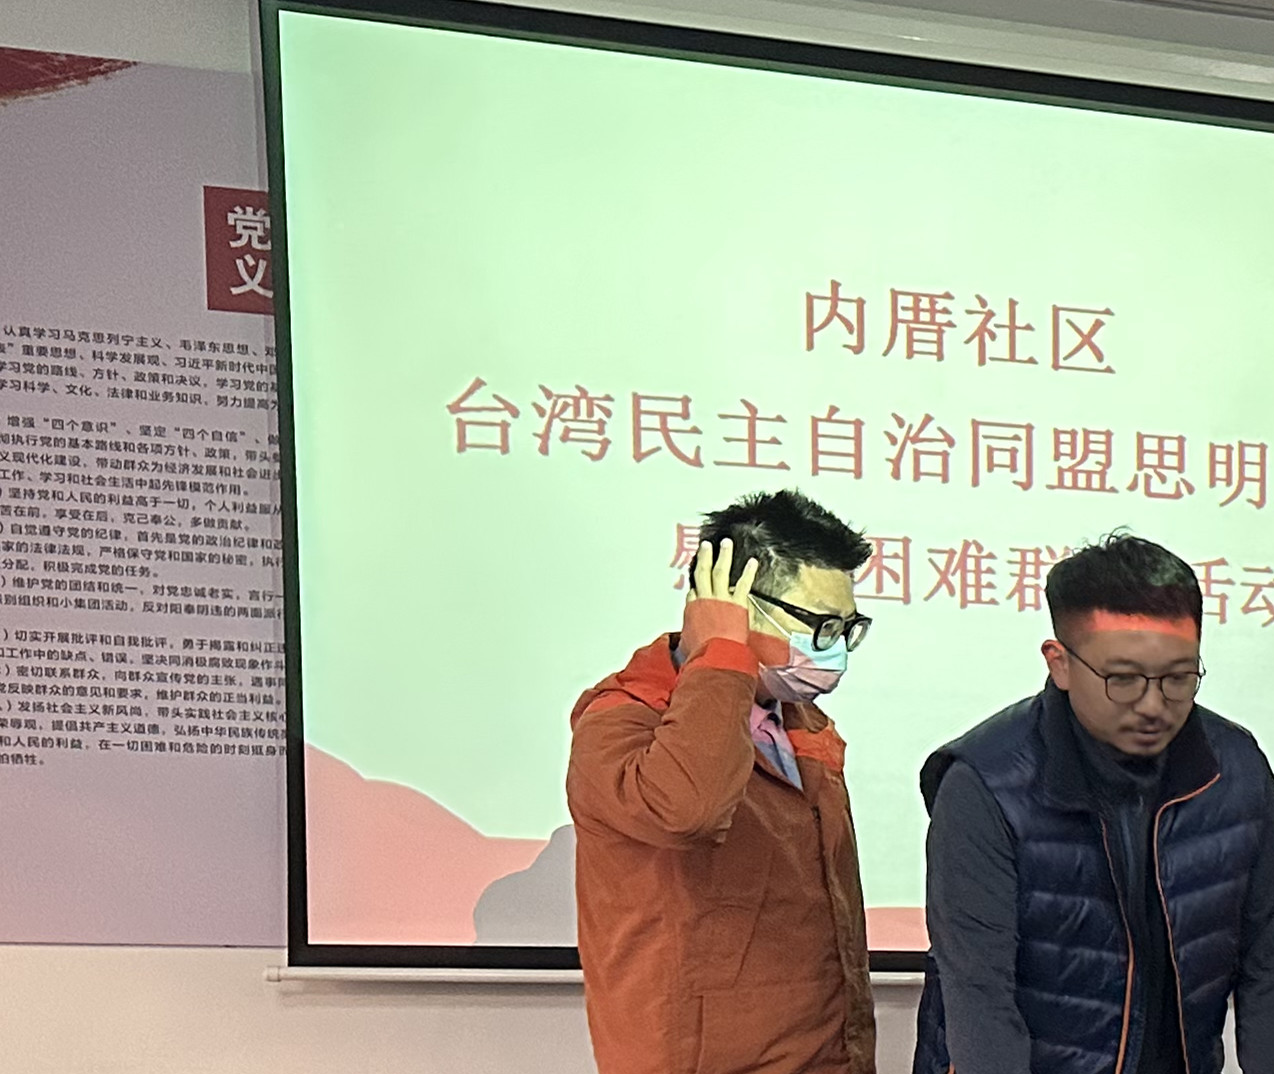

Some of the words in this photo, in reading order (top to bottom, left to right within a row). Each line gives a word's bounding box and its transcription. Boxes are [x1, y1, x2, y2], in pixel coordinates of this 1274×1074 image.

[227, 205, 272, 252] 党
[230, 255, 275, 297] 义
[803, 280, 1117, 376] 内厝社区
